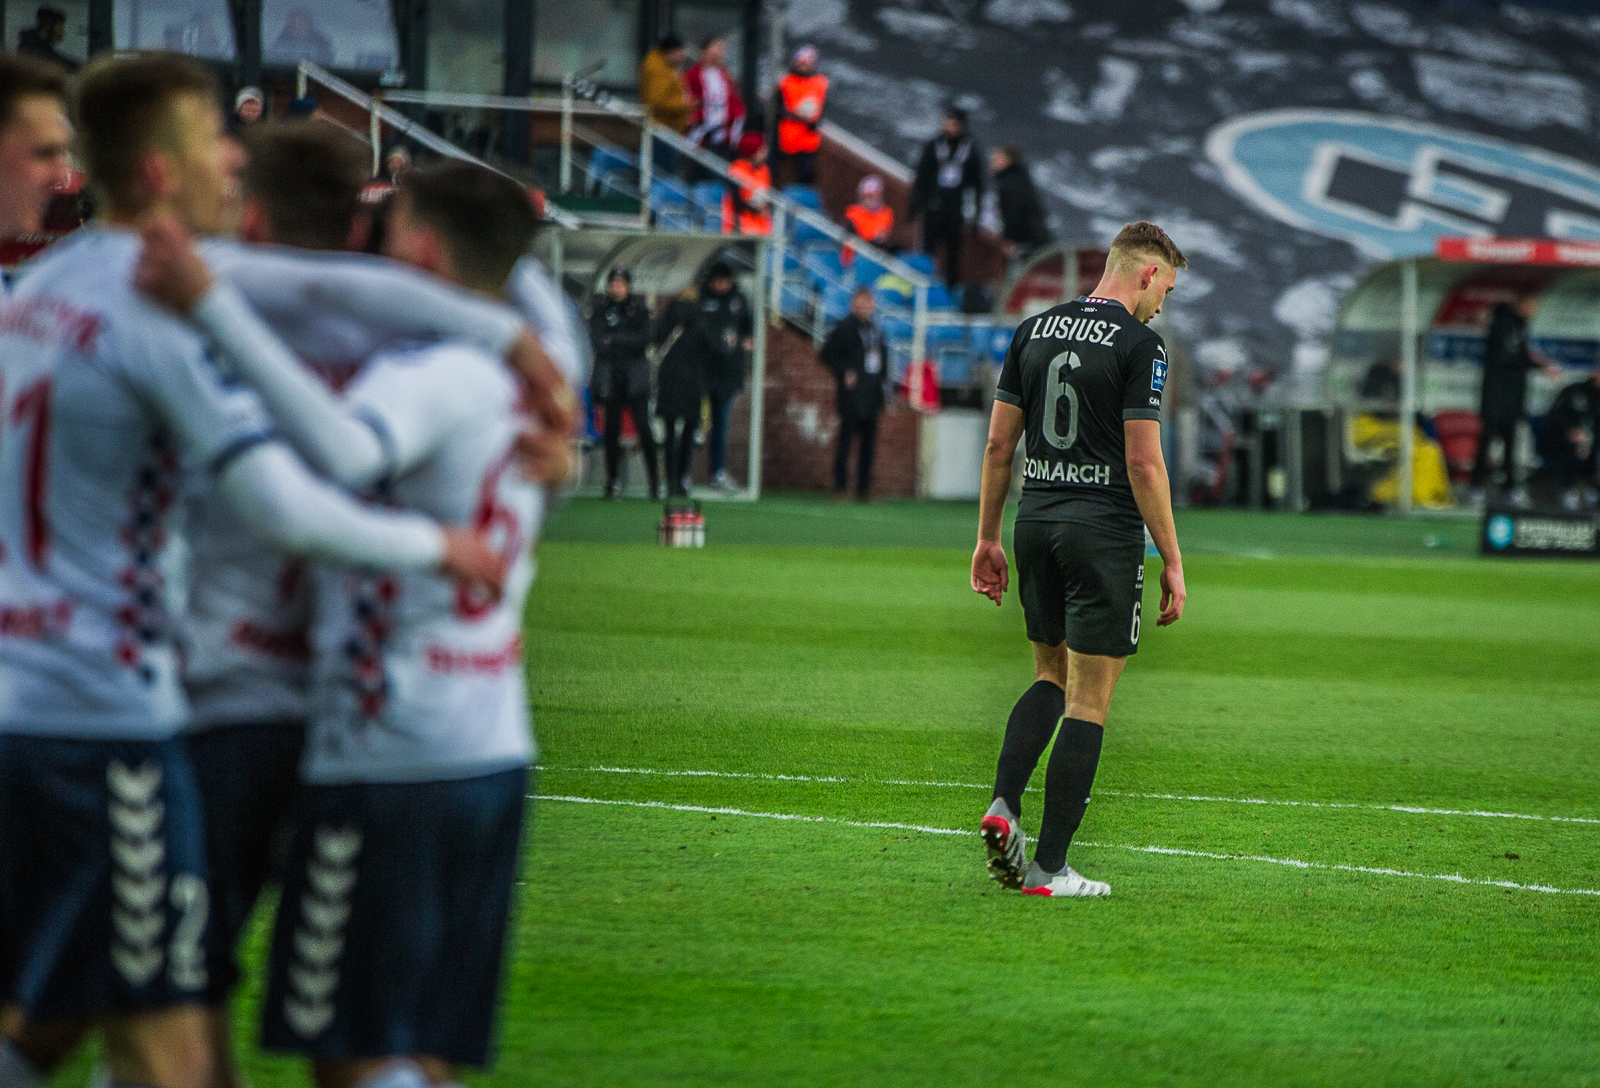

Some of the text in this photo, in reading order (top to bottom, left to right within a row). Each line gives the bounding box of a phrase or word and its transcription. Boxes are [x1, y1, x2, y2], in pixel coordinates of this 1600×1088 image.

[1030, 315, 1122, 347] LUSIUSZ
[1042, 350, 1082, 450] 6
[1130, 601, 1140, 645] 6
